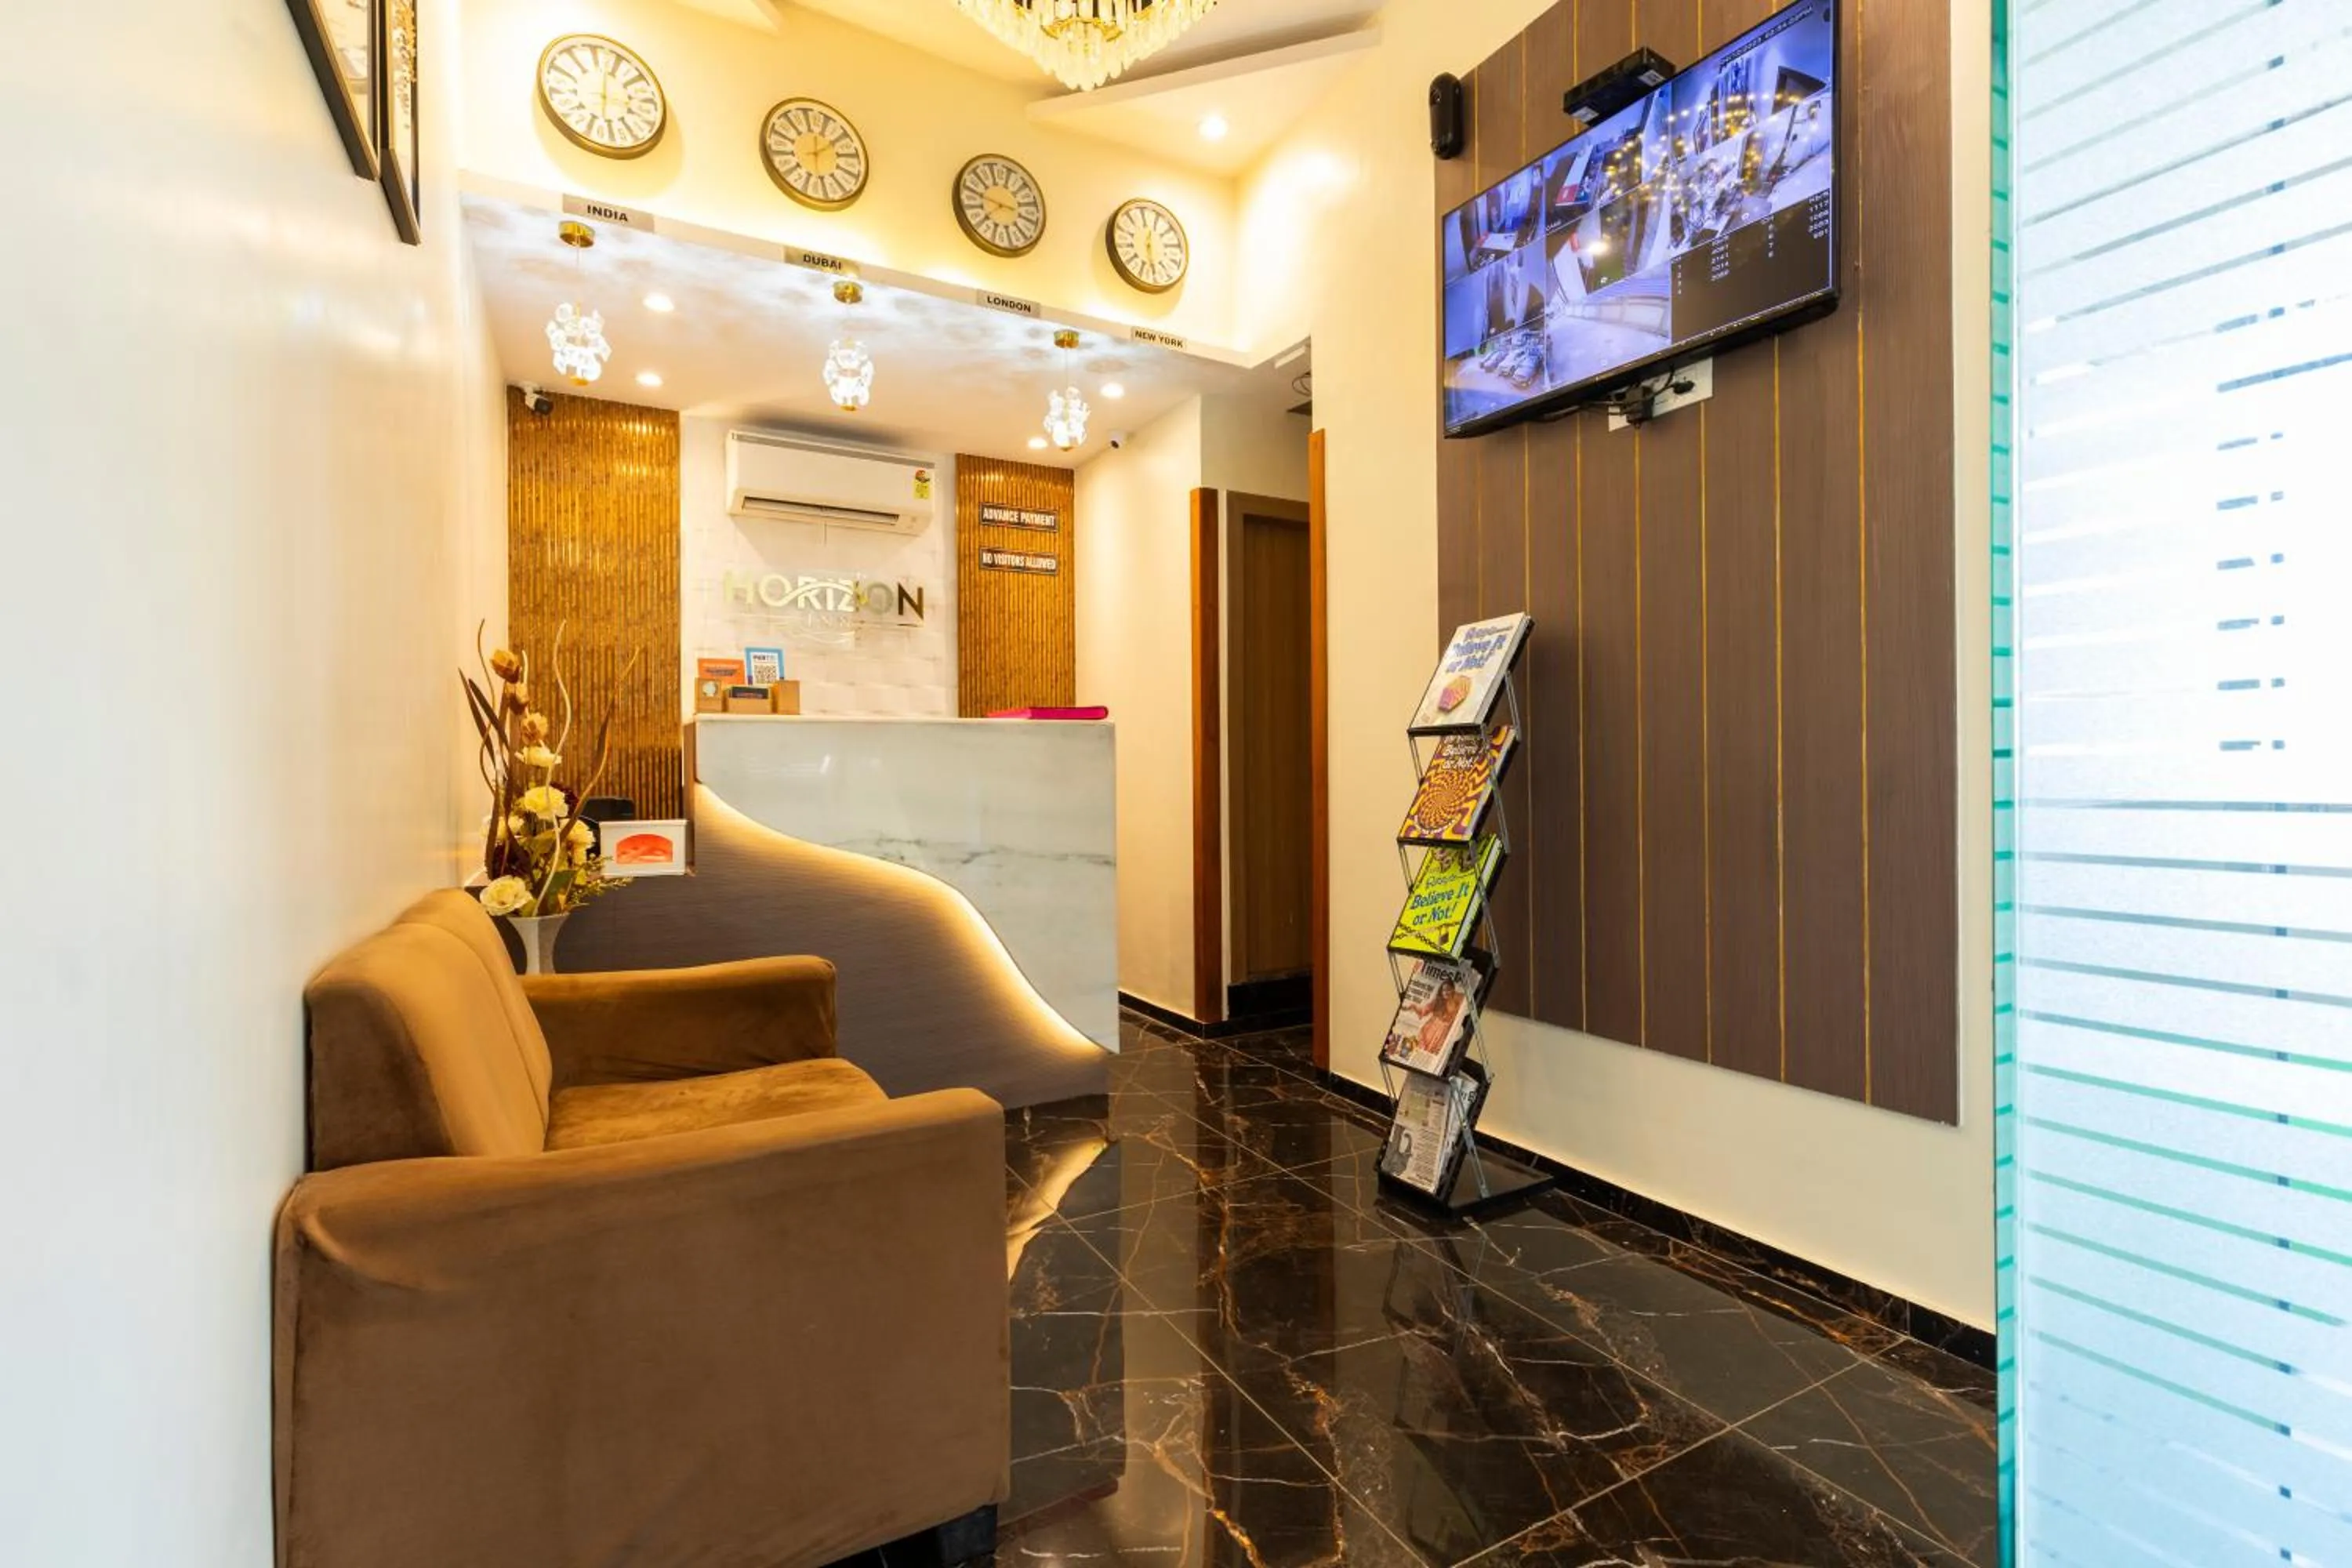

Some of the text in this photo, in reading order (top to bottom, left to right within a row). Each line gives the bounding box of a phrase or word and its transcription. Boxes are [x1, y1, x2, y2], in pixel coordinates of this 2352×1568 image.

[587, 205, 629, 222] INDIA
[803, 253, 841, 270] DUBAI
[986, 295, 1031, 313] LONDON
[1134, 330, 1183, 348] NEW YORK
[982, 507, 1054, 526] ADVANCE PAYMENT
[982, 552, 1056, 570] NO VISITORS ALLOWED
[722, 568, 924, 621] HORIZON
[1410, 889, 1454, 909] Believe
[1457, 880, 1470, 899] It
[1412, 913, 1428, 926] or
